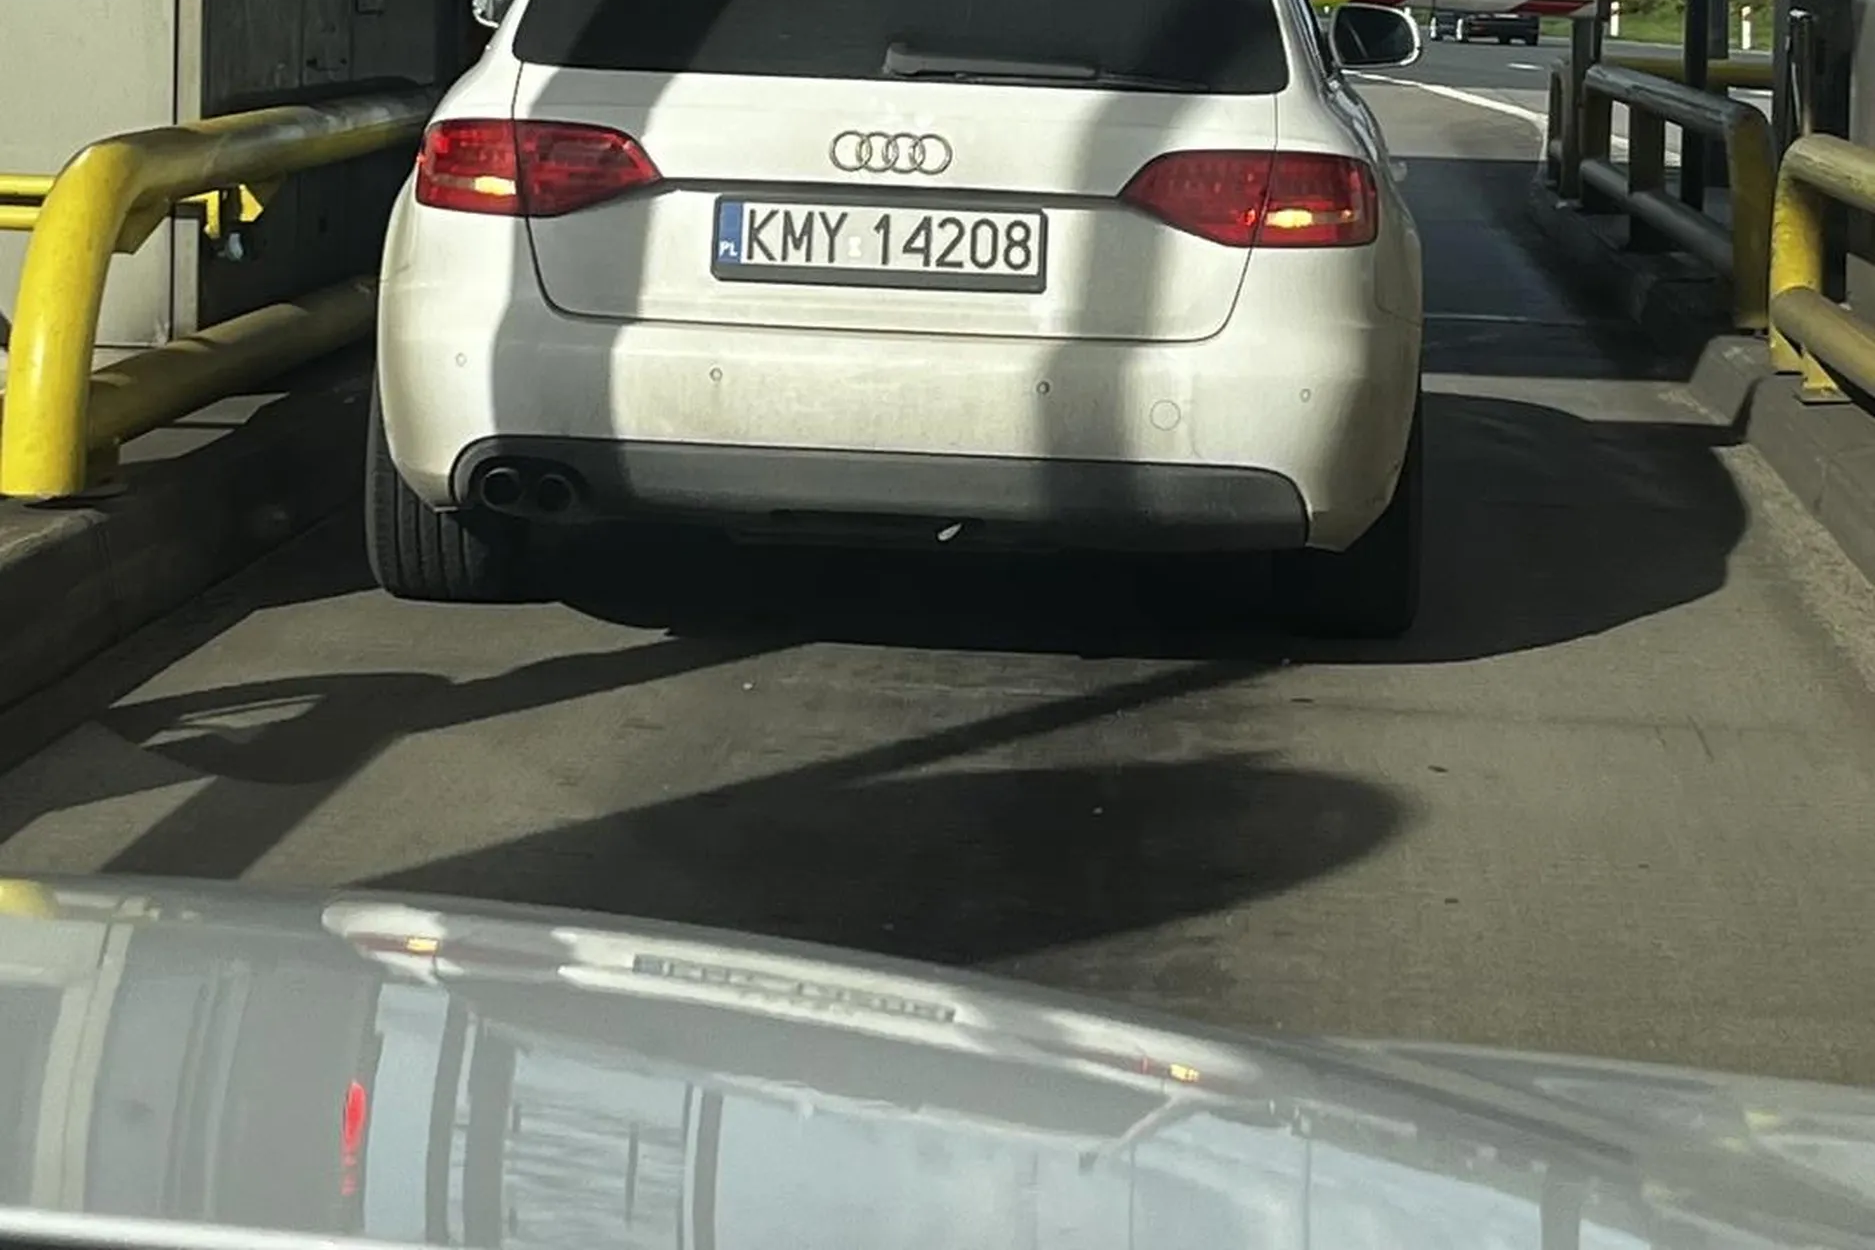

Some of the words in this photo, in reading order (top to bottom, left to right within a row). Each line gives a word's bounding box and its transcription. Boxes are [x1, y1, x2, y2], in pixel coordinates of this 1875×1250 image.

[719, 240, 738, 257] PL
[746, 208, 848, 263] KMY
[873, 213, 1032, 270] 14208
